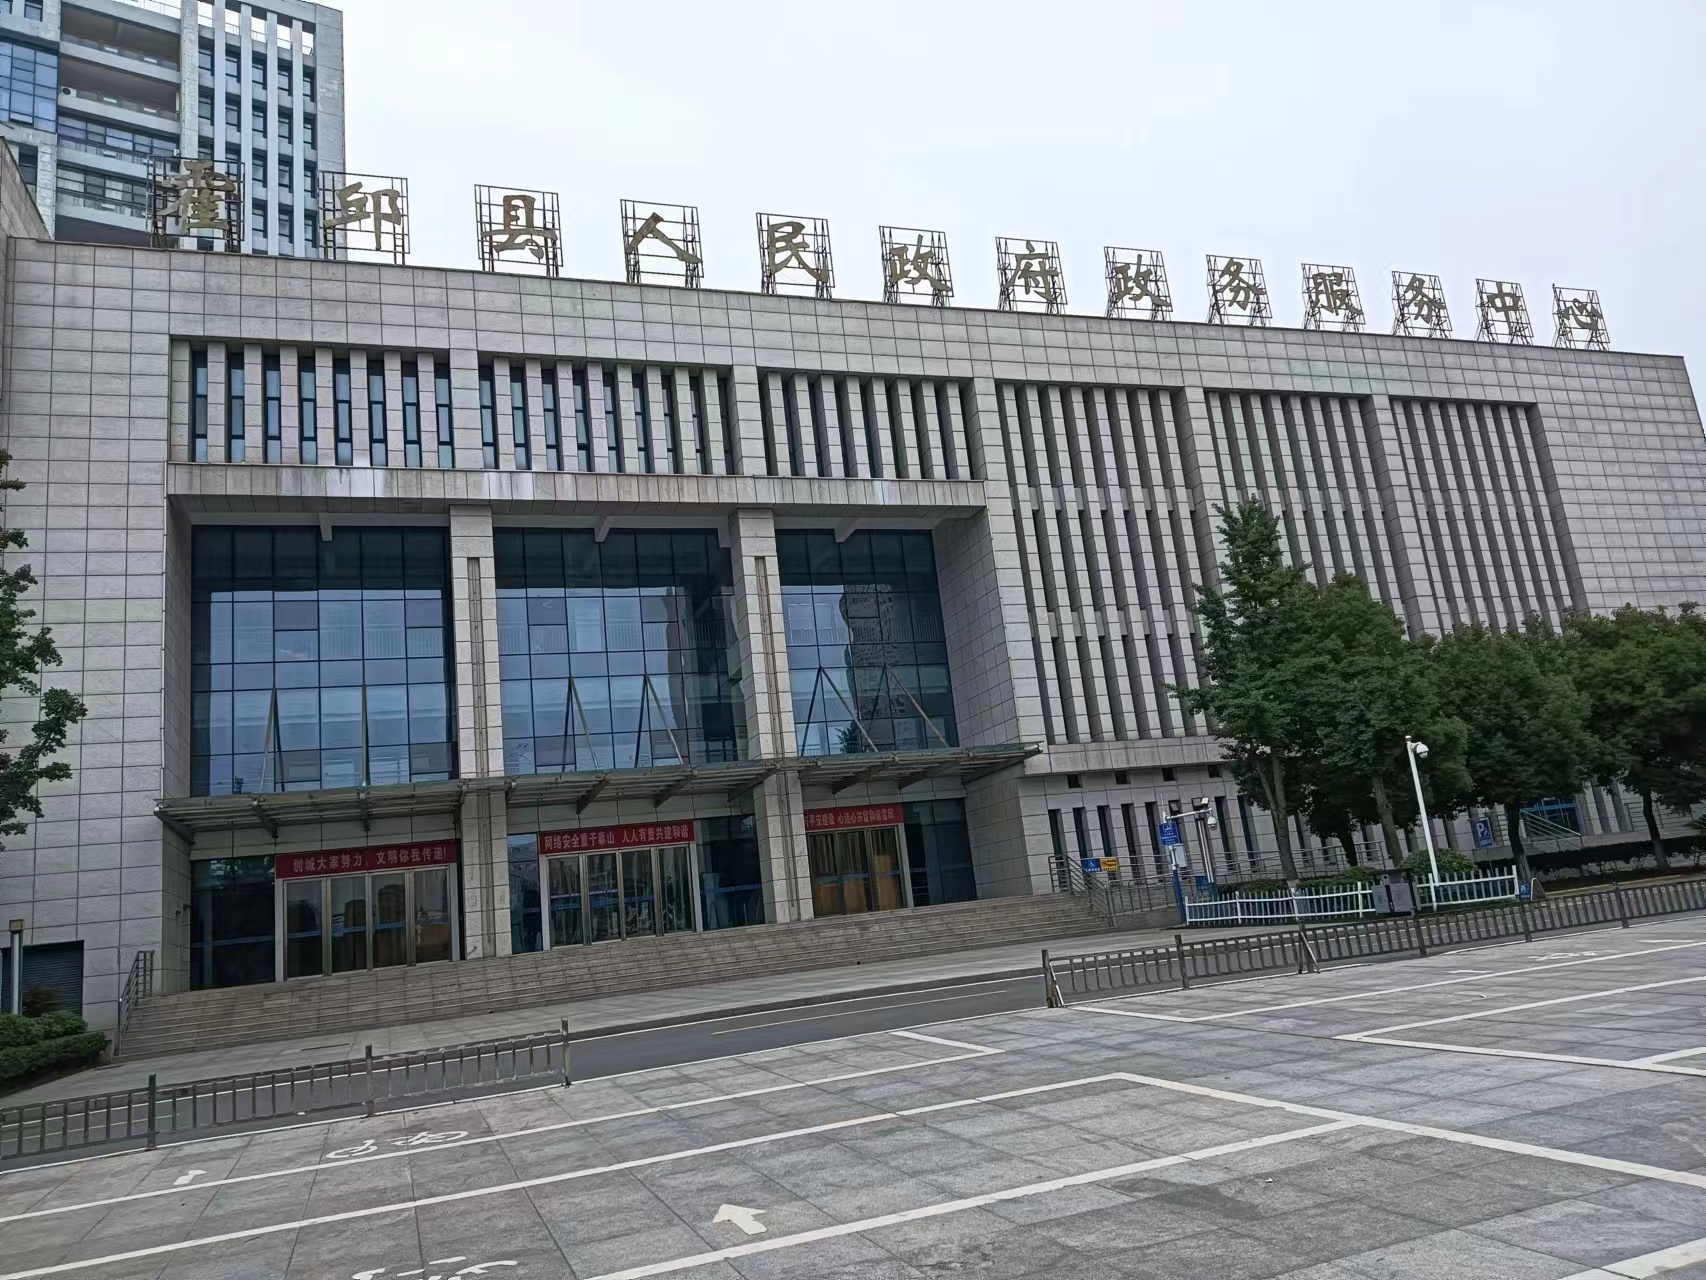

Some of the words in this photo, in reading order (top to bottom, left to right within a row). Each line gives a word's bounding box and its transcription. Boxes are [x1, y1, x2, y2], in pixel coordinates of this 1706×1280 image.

[157, 158, 1602, 335] 霍邱县人民政府政务服务中心
[544, 830, 615, 851] 网络安全重于泰山
[621, 824, 689, 843] 人人有责共建和谐
